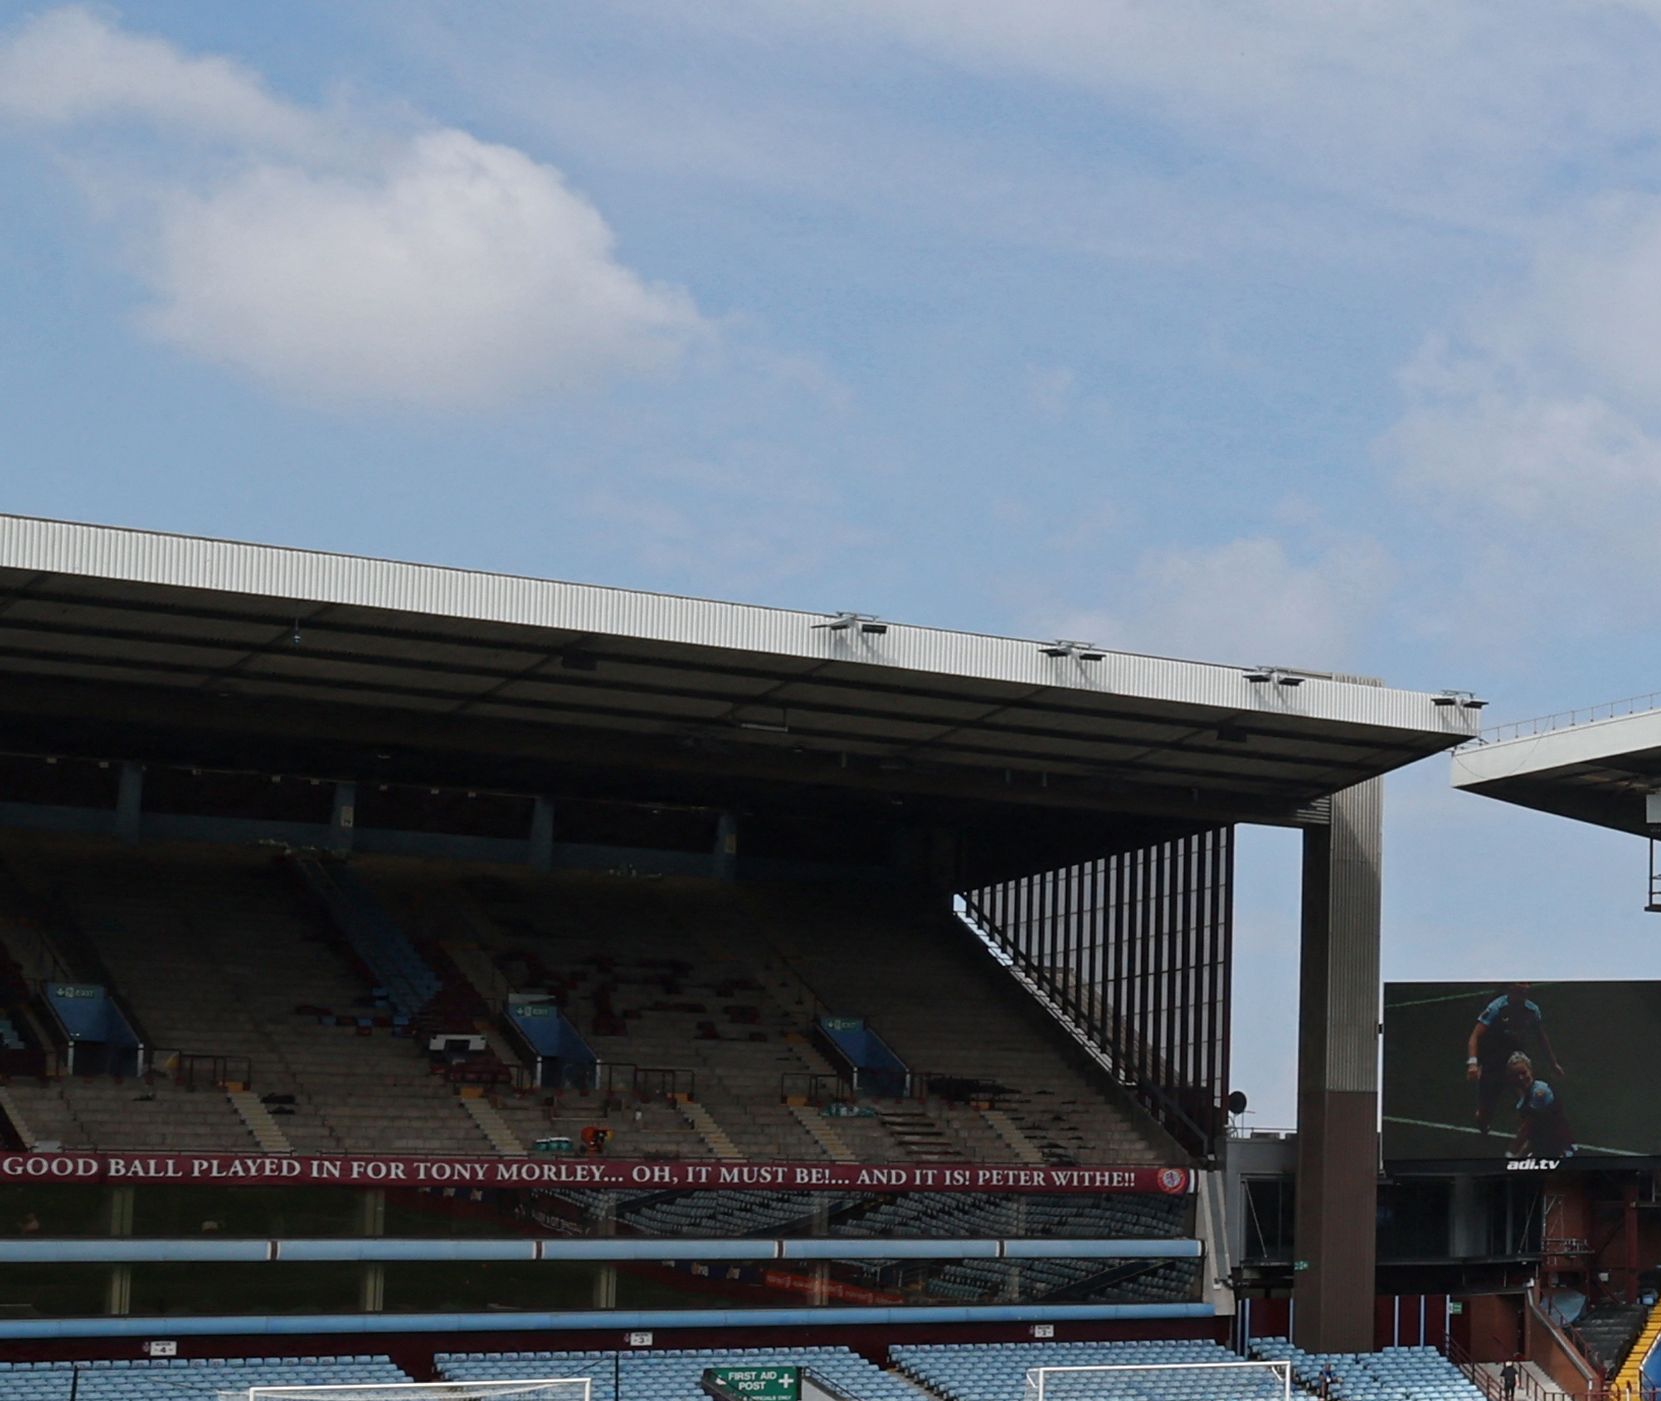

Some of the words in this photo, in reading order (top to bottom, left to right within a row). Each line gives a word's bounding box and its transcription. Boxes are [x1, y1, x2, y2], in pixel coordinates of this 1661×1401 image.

[1506, 1158, 1560, 1171] adi.tv
[2, 1157, 99, 1176] GOOD
[108, 1158, 183, 1177] BALL
[191, 1159, 301, 1177] PLAYED
[310, 1161, 341, 1178] IN
[350, 1161, 407, 1179] FOR
[413, 1162, 489, 1180] TONY
[496, 1163, 624, 1182] MORLEY...
[632, 1165, 679, 1184] OH,
[686, 1166, 712, 1183] IT
[719, 1166, 788, 1183] MUST
[795, 1167, 850, 1185] BE!...
[856, 1169, 907, 1186] AND
[914, 1169, 938, 1186] IT
[944, 1169, 970, 1186] IS!
[977, 1169, 1046, 1187] PETER
[1049, 1170, 1136, 1188] WITHE!!
[728, 1371, 757, 1381] FIRST
[760, 1371, 777, 1380] AID
[738, 1381, 766, 1391] POST
